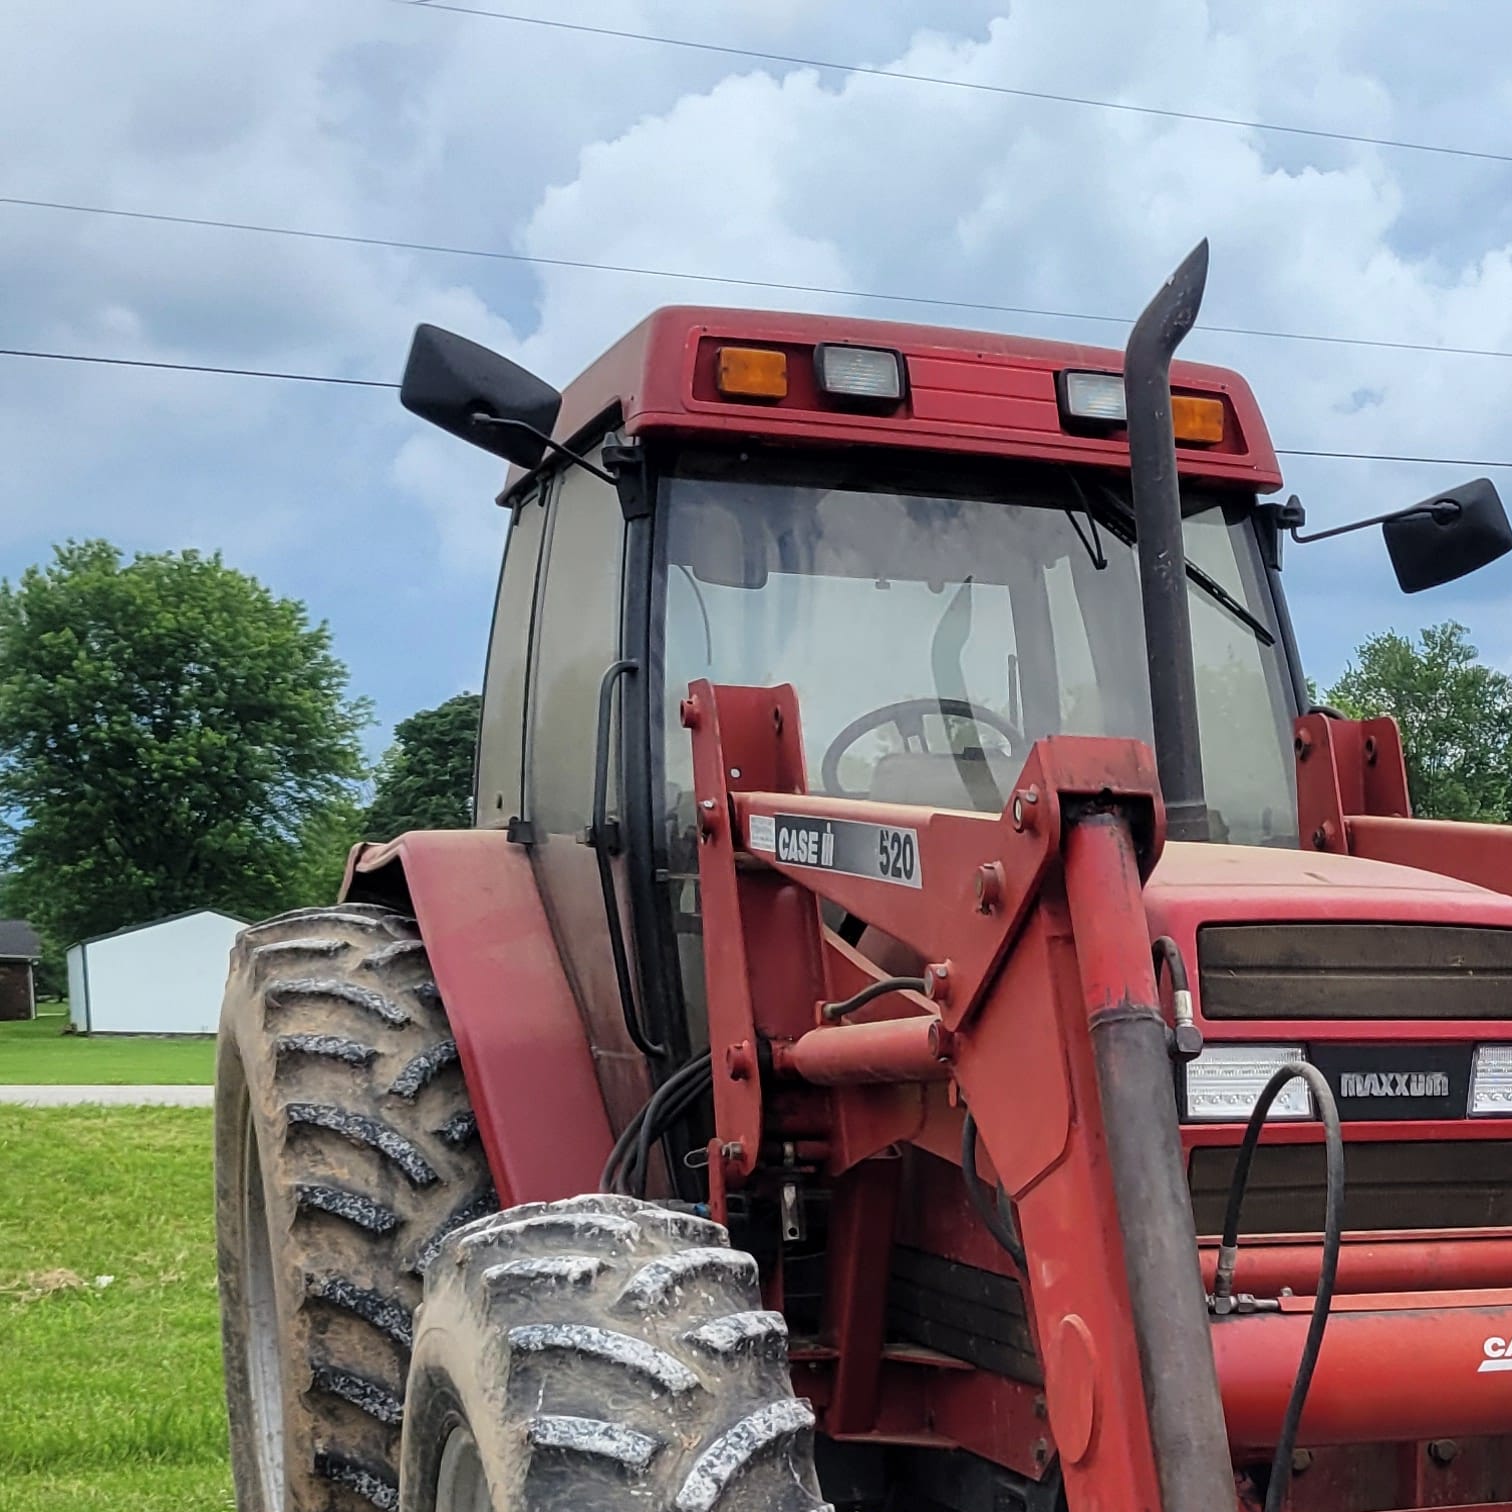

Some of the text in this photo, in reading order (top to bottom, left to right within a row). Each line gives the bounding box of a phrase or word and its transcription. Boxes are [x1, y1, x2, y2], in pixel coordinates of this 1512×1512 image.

[779, 827, 818, 864] CASE
[879, 830, 914, 880] 520
[1341, 1072, 1449, 1097] MAXXUM
